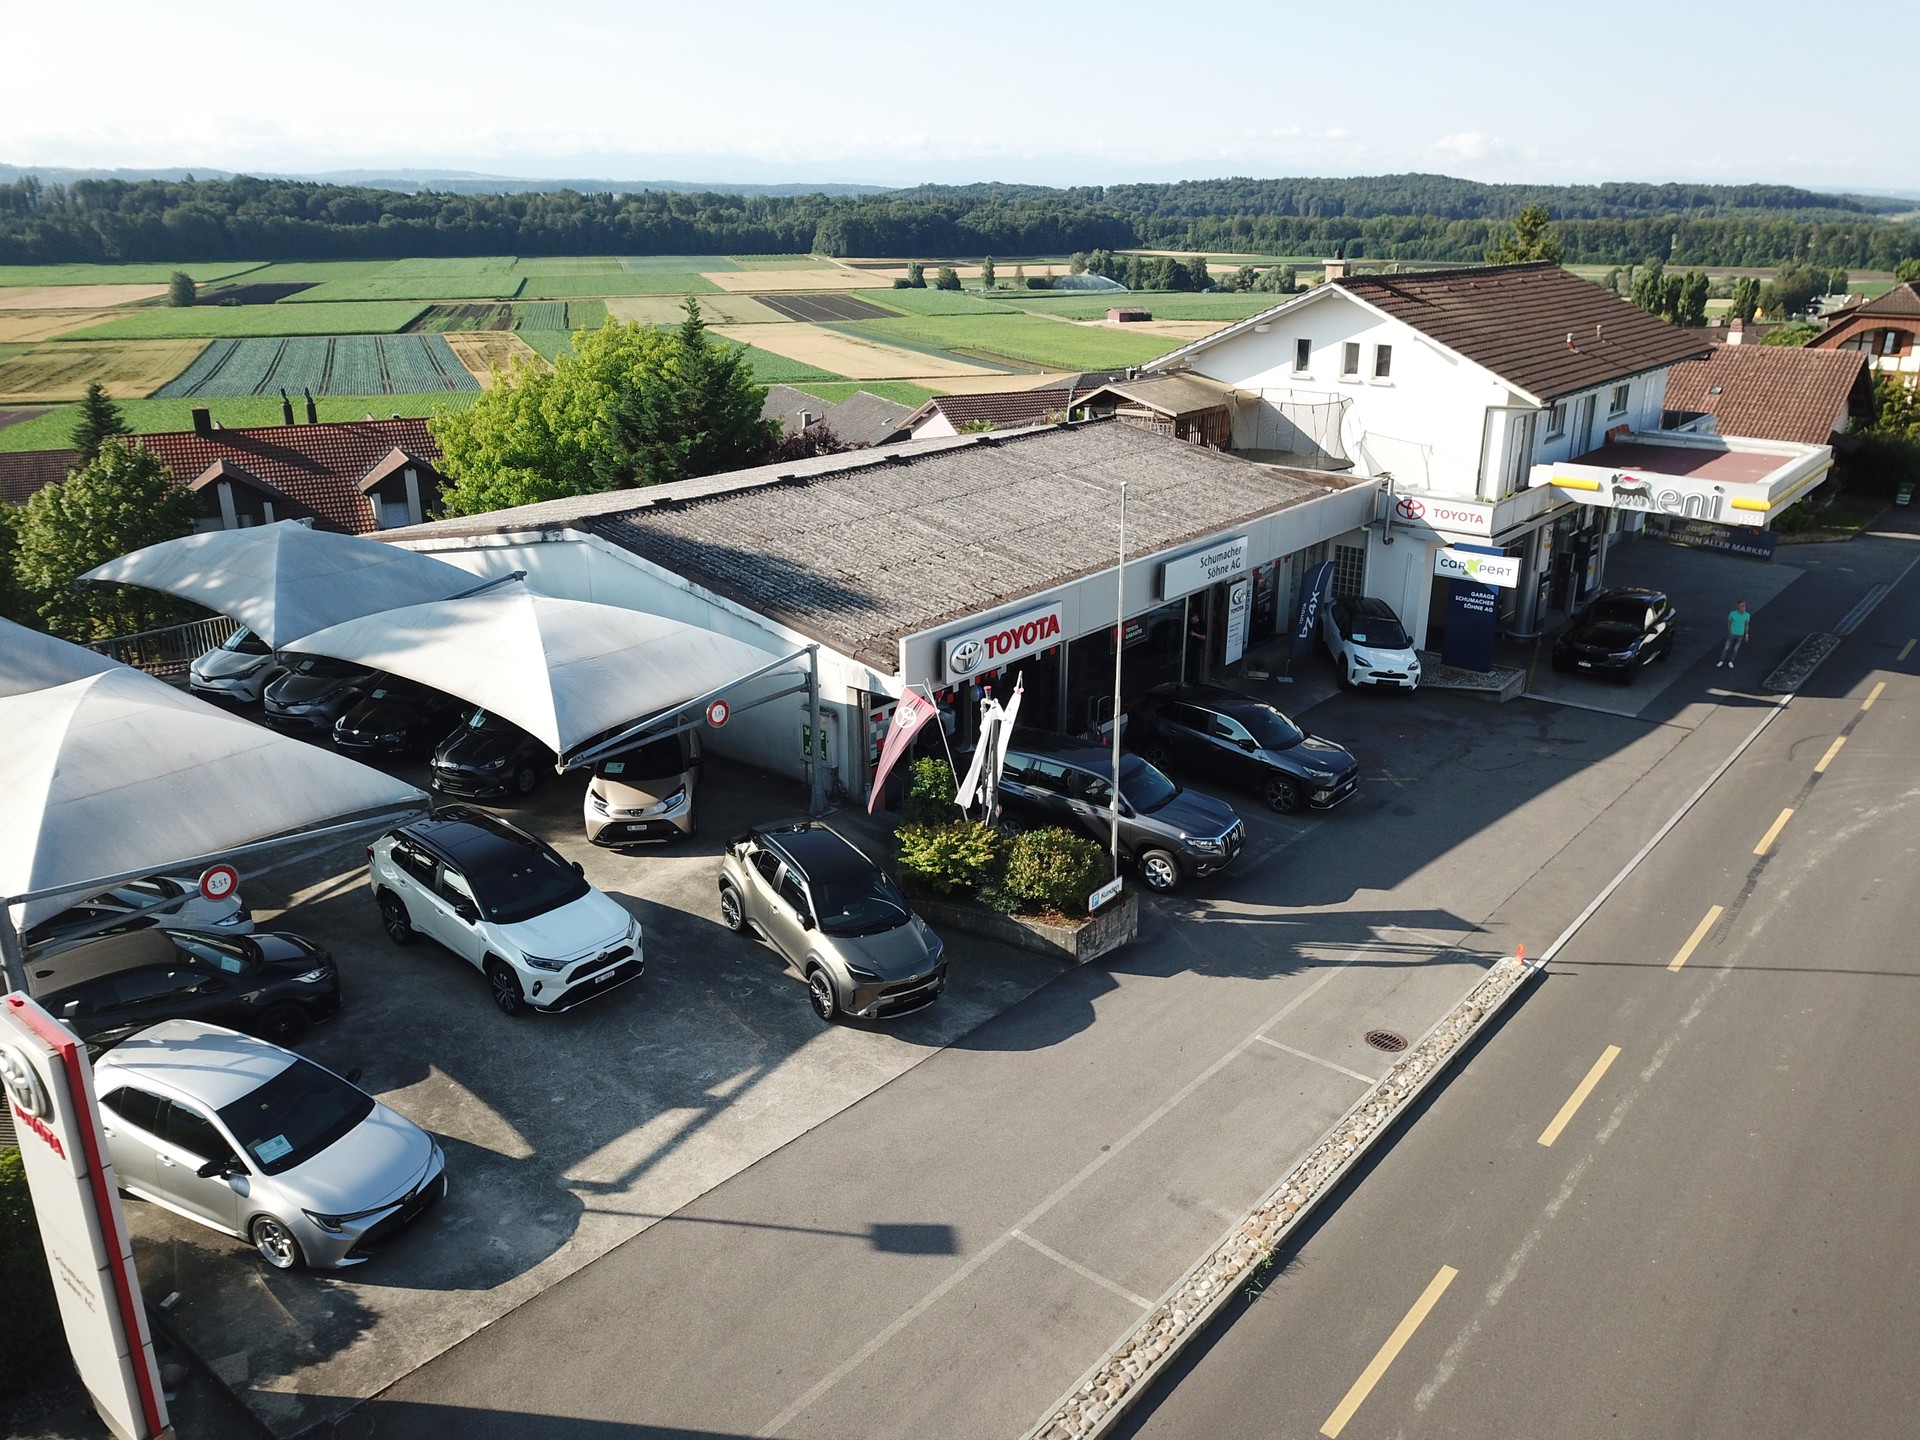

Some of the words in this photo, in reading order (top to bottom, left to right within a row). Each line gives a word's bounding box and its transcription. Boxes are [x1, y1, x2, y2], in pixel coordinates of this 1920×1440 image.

[1657, 485, 1720, 519] eni
[1433, 508, 1483, 524] TOYOTA
[1200, 546, 1242, 569] Schumacher
[1704, 539, 1730, 550] ALLER
[1732, 543, 1771, 557] MARKEN
[1207, 564, 1229, 580] Söhne
[1230, 557, 1241, 571] AG
[1455, 595, 1495, 606] SCHUMACHER
[1470, 591, 1495, 600] GARAGE
[1299, 602, 1307, 625] TOYOTA
[1463, 602, 1483, 611] SÖHNE
[984, 613, 1060, 659] TOYOTA
